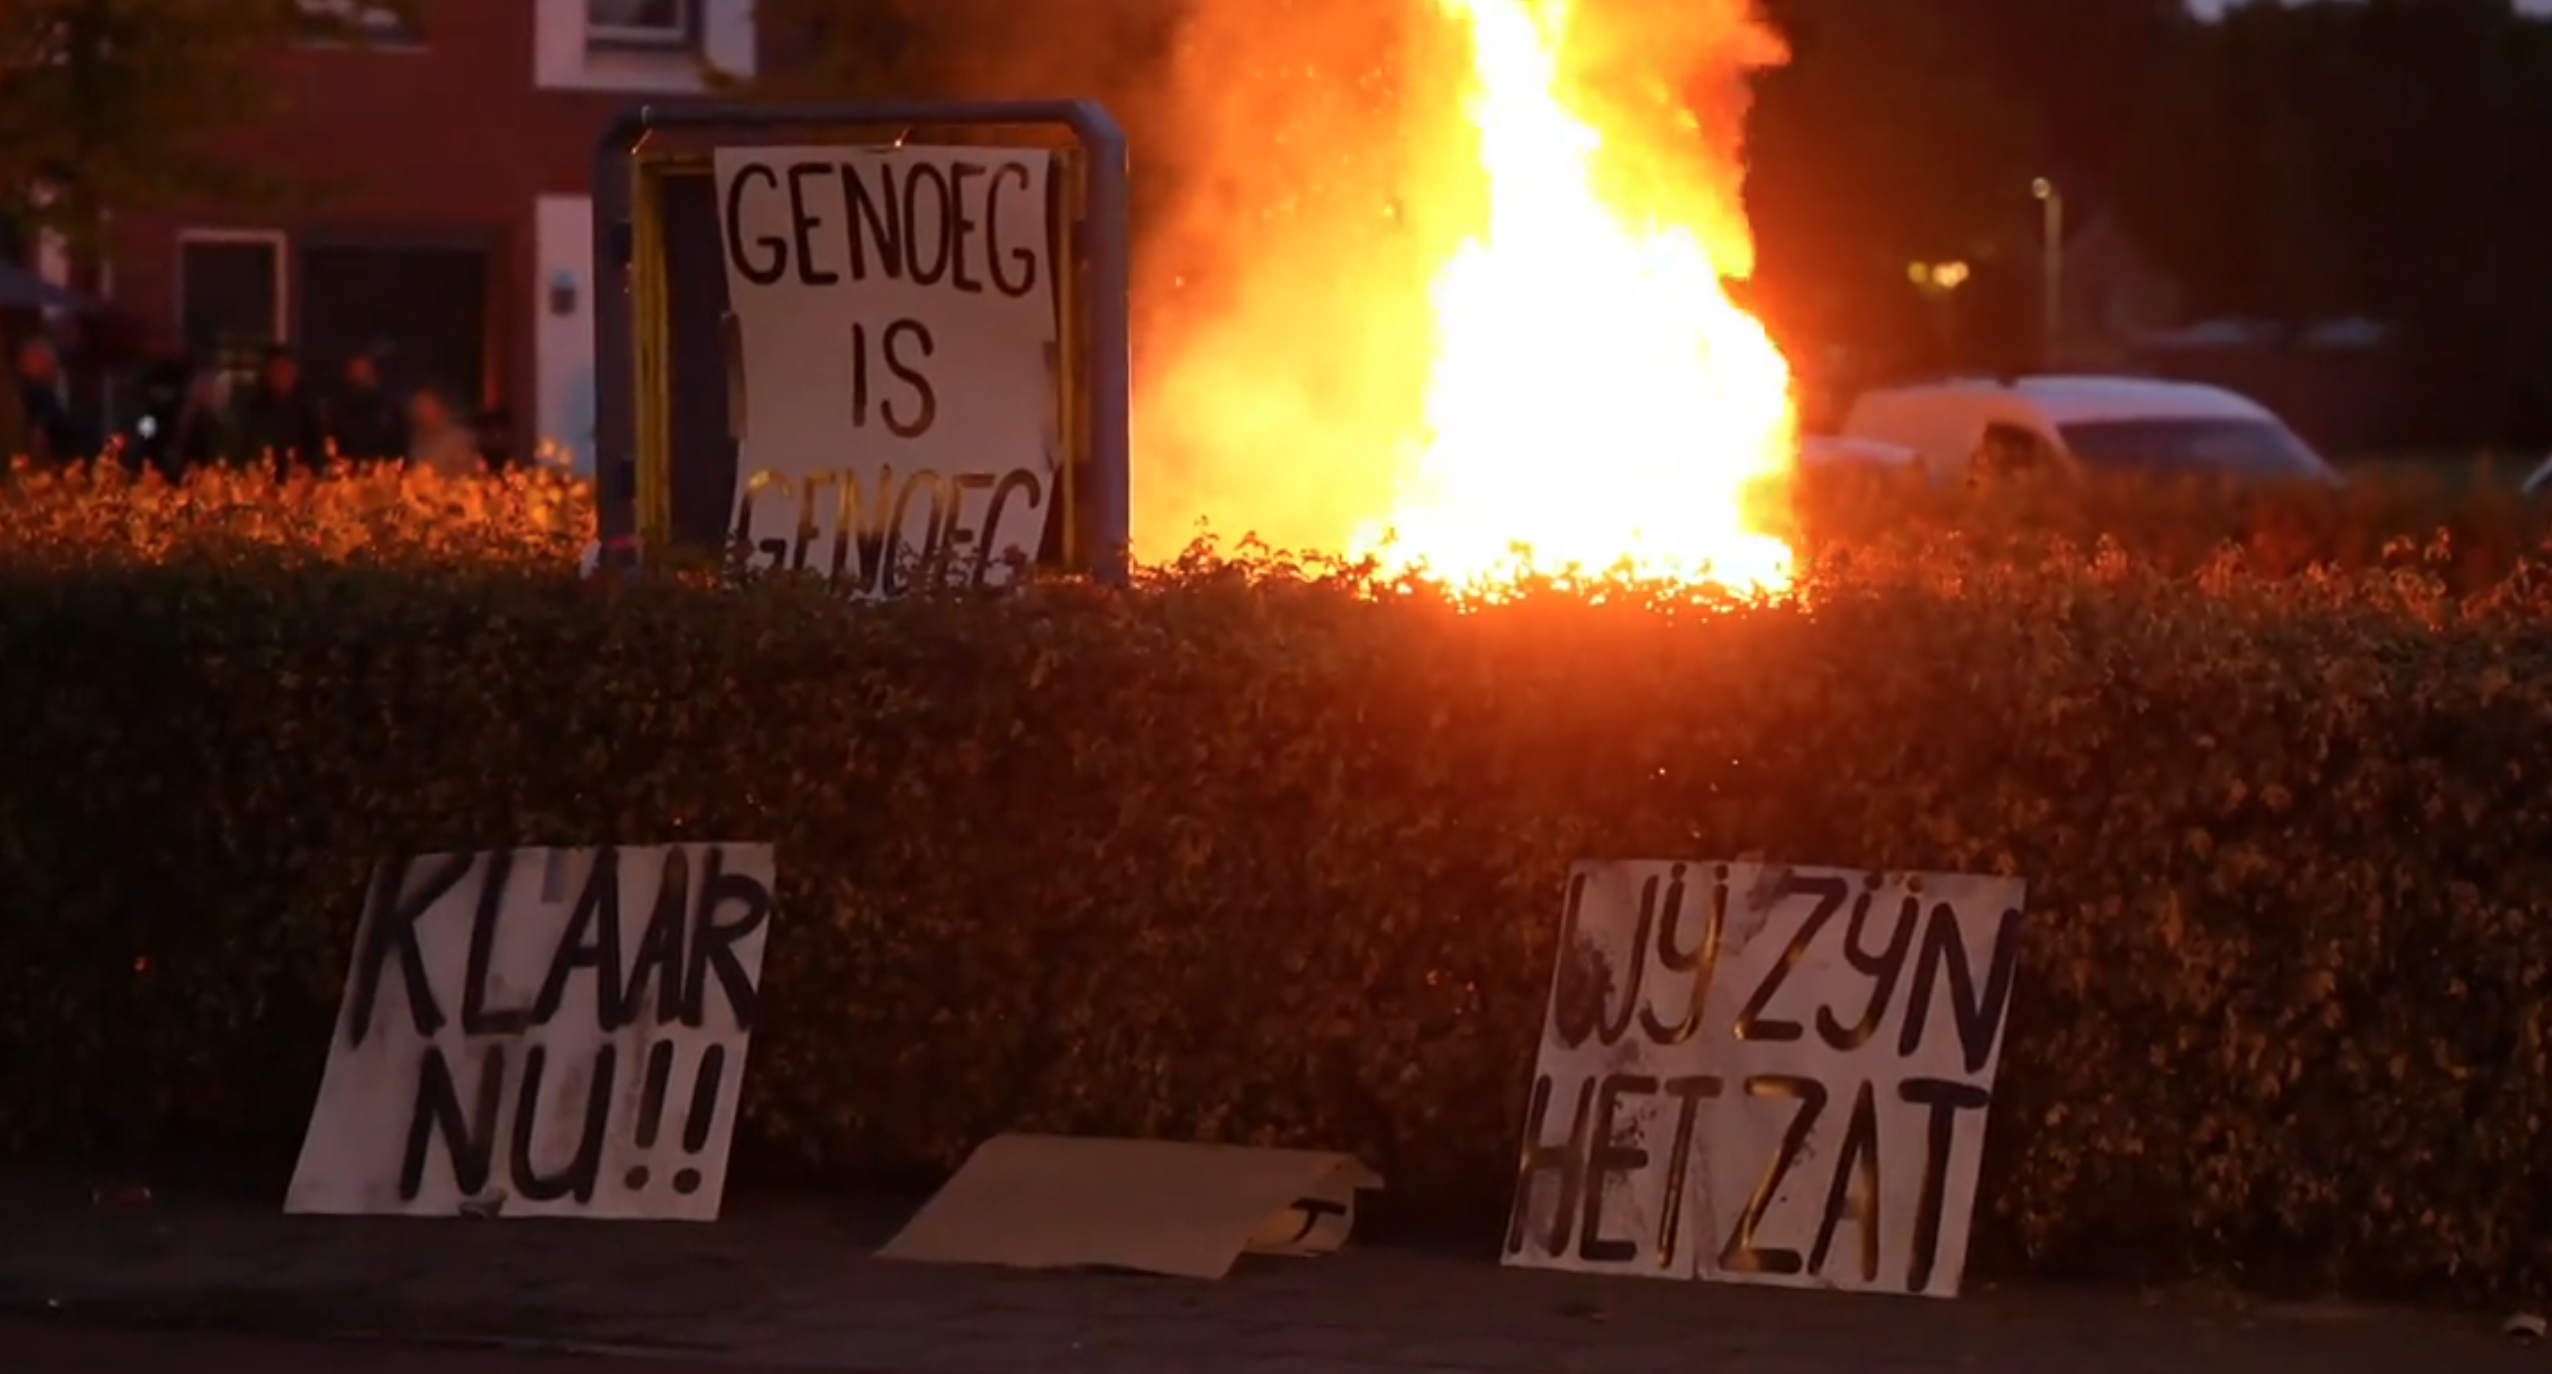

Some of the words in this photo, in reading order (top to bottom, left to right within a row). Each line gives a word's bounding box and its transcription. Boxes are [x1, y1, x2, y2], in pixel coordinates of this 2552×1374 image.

[726, 162, 1037, 298] GENOEG
[851, 318, 937, 438] IS
[348, 846, 774, 1051] KLAAR
[401, 1038, 725, 1204] NU!!
[1507, 1074, 1724, 1269] HET
[1717, 1075, 1991, 1293] ZAT
